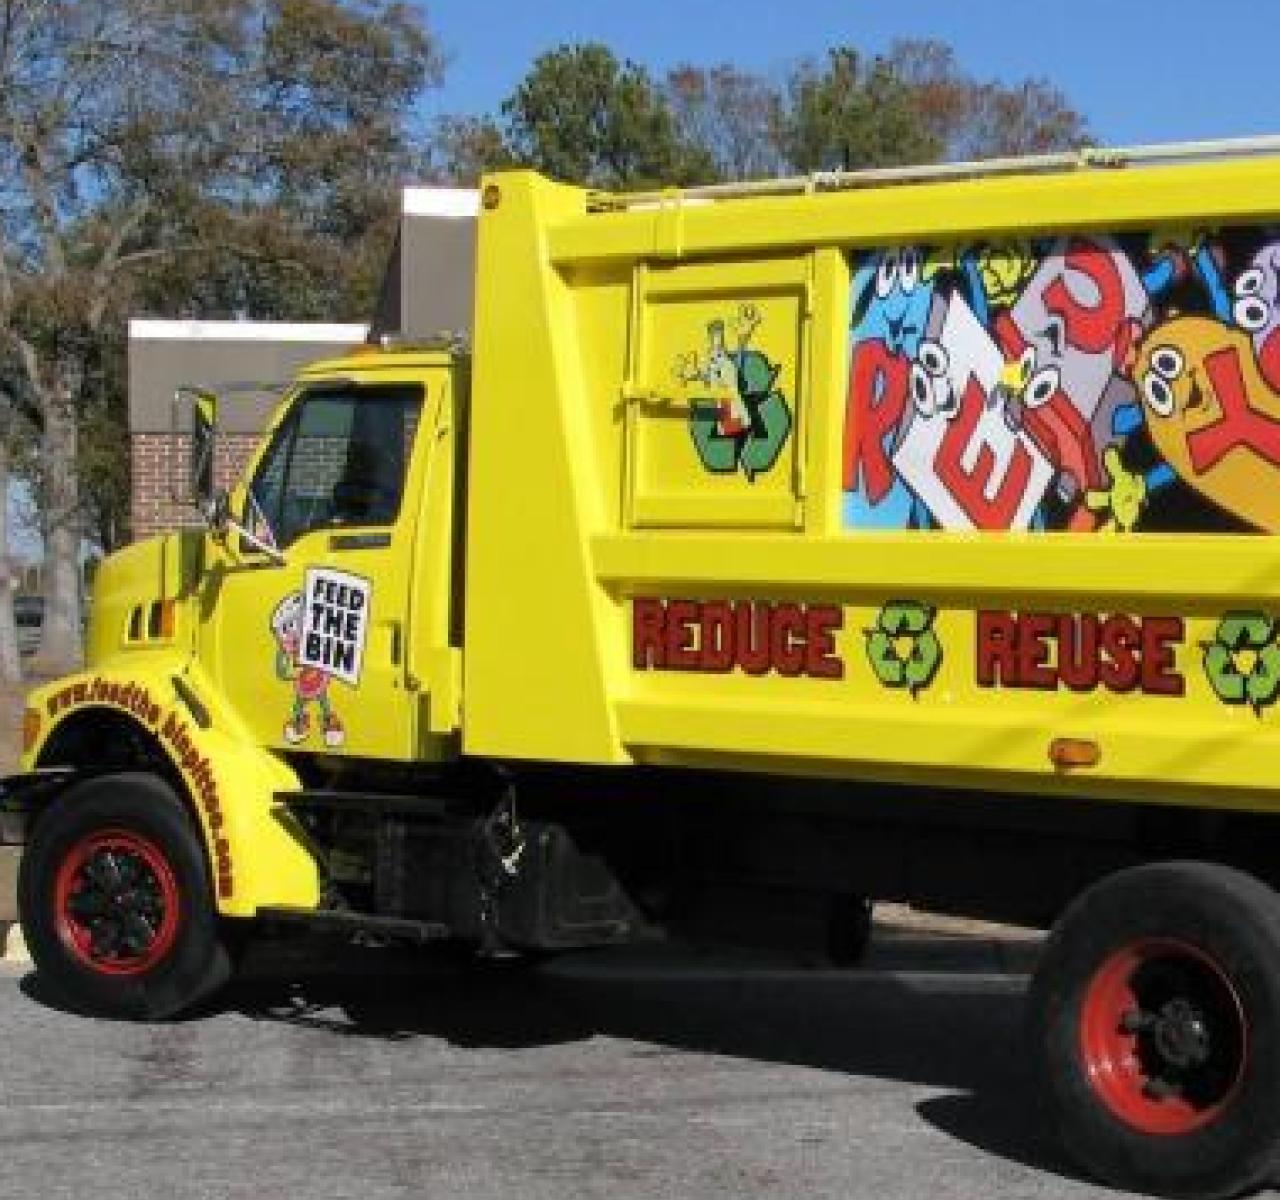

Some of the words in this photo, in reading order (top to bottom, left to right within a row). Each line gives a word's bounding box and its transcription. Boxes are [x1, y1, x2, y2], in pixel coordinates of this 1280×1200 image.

[313, 577, 364, 610] FEED
[313, 603, 360, 640] THE
[306, 634, 355, 673] BIN
[632, 599, 844, 677] REDUCE
[976, 611, 1186, 696] REUSE
